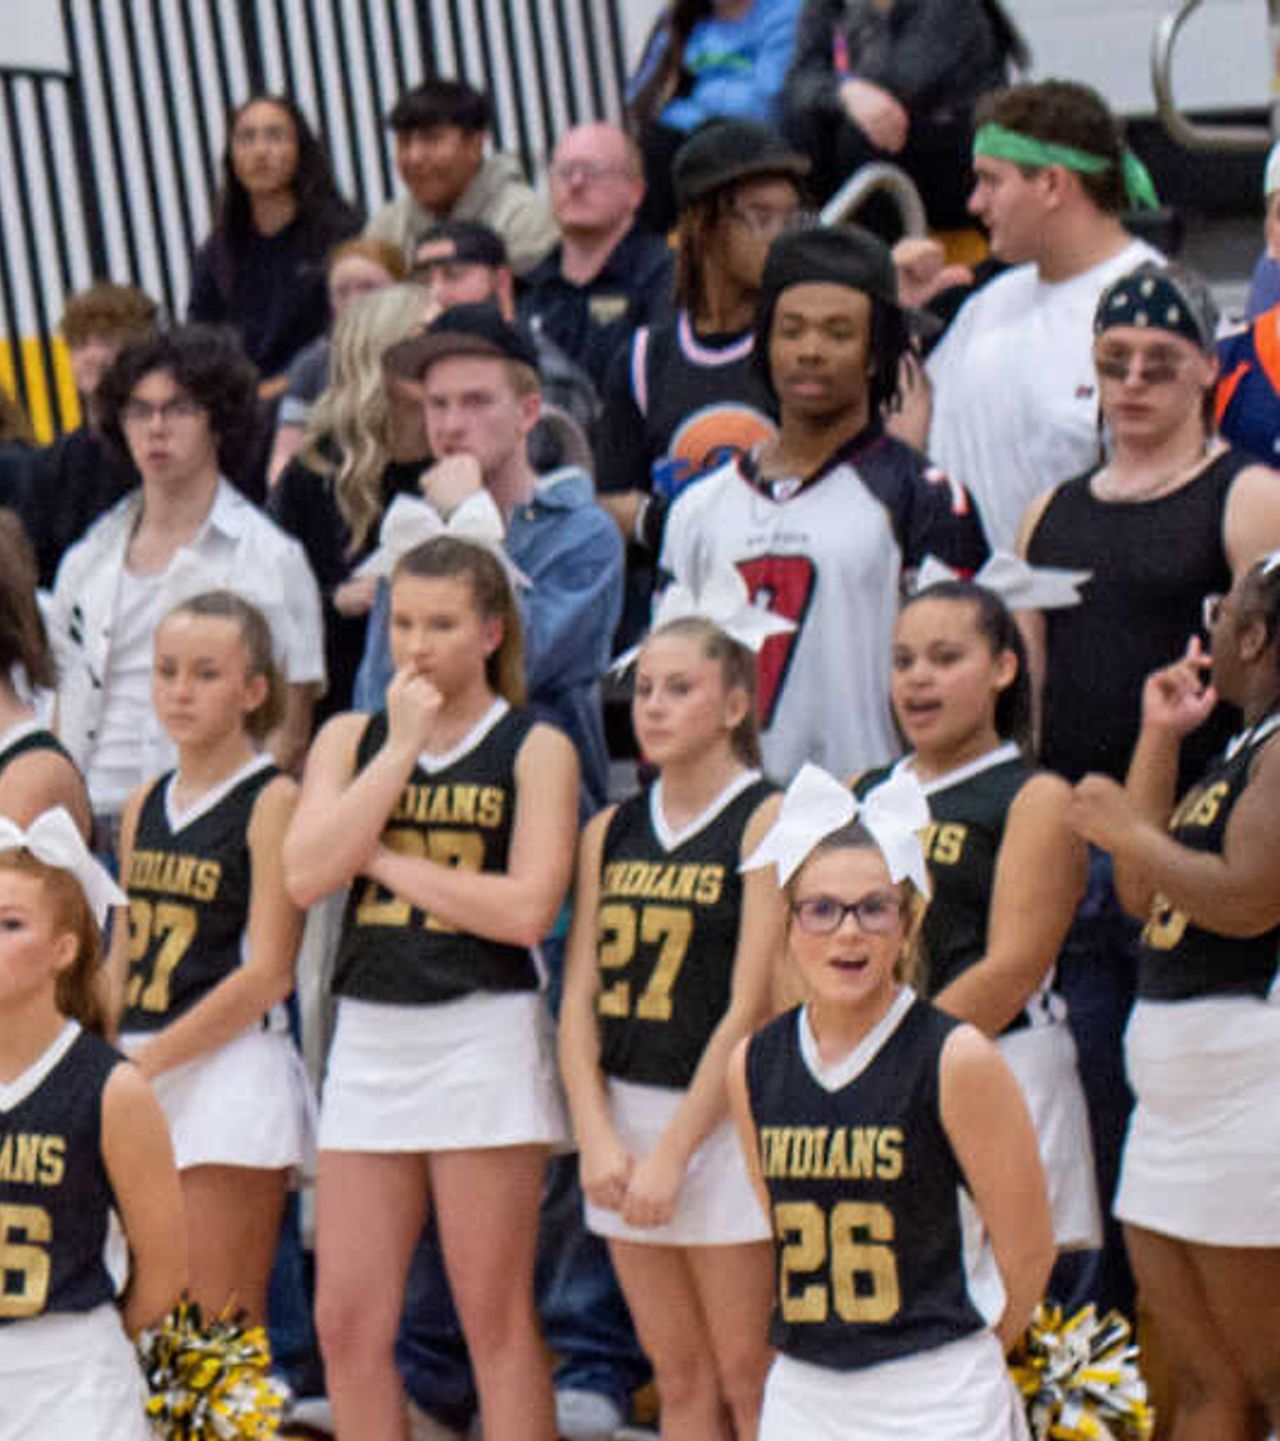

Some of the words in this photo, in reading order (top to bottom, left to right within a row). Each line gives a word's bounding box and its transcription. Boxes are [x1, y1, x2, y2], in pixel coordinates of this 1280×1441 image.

[597, 905, 694, 1022] 27
[760, 1126, 906, 1180] INDIANS
[775, 1202, 901, 1323] 26
